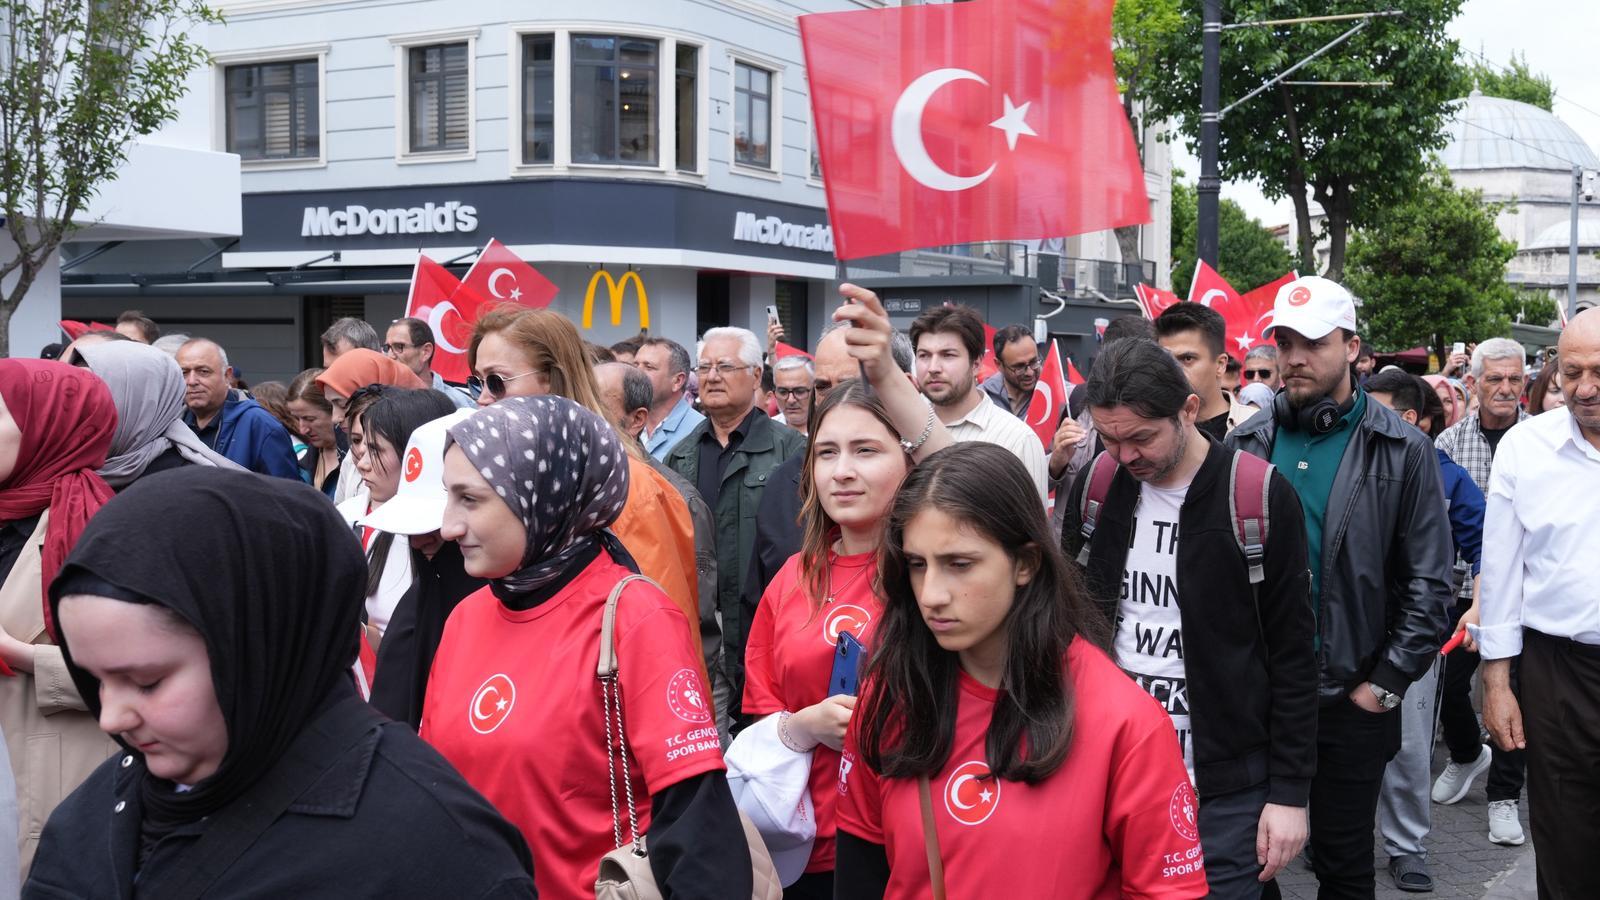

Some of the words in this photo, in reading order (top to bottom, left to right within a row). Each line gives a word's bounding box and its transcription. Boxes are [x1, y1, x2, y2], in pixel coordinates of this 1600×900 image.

[301, 201, 478, 236] McDonald's
[733, 211, 835, 252] McDonald
[665, 734, 686, 748] T.C.
[666, 744, 696, 762] SPOR
[1164, 852, 1184, 864] T.C.
[1163, 863, 1193, 877] SPOR
